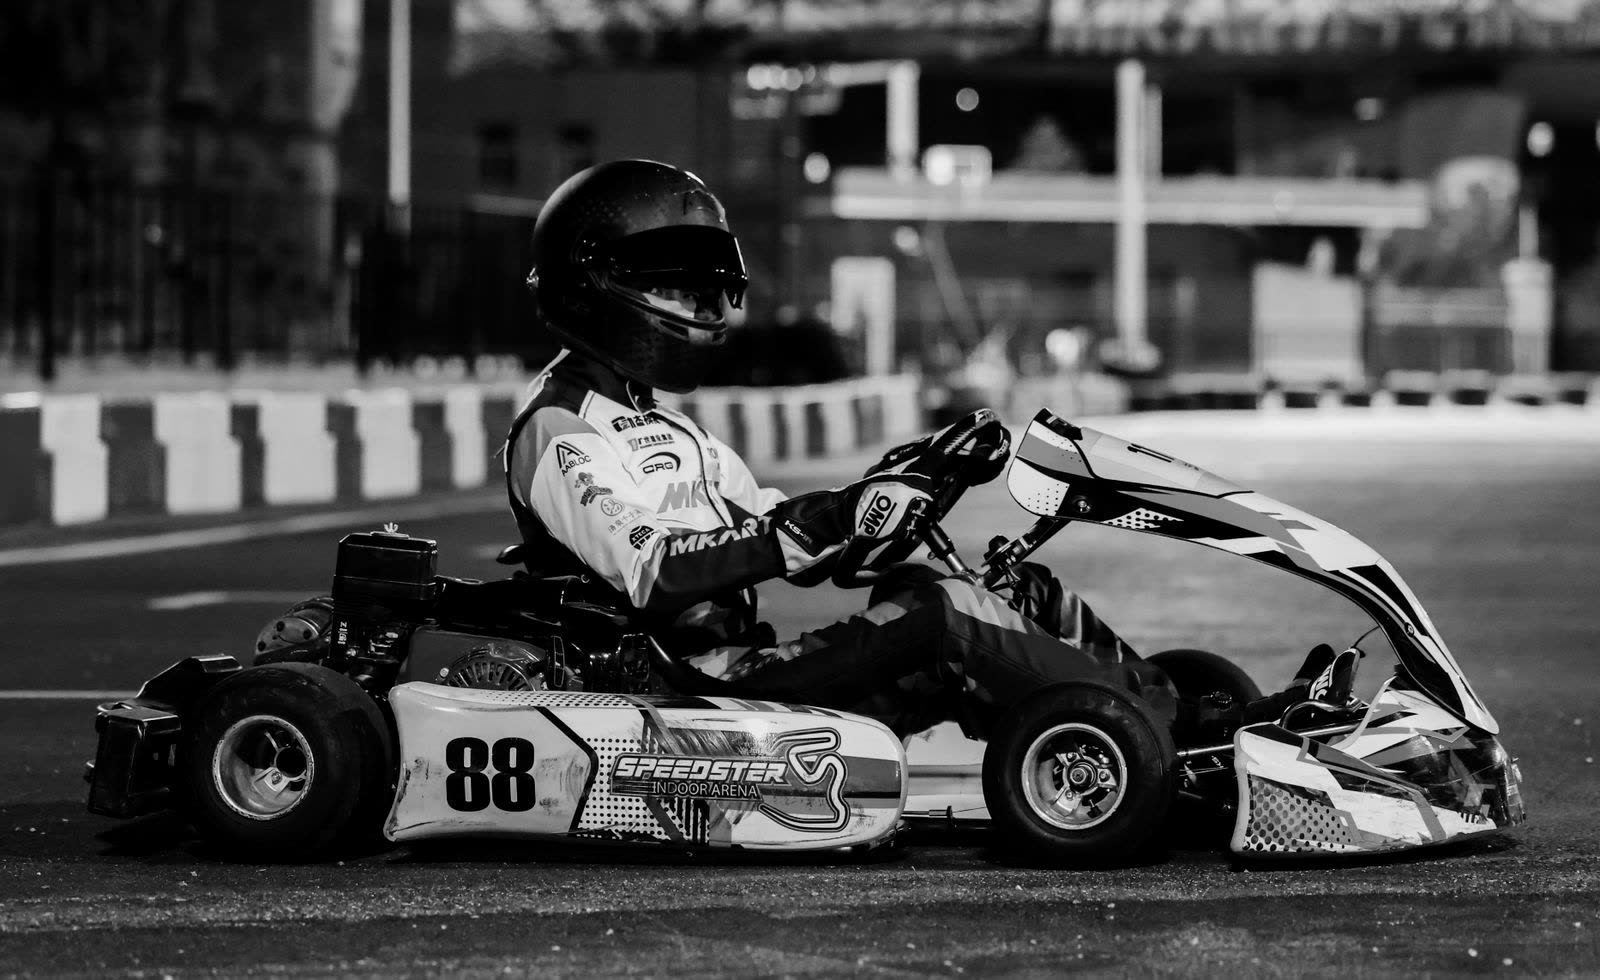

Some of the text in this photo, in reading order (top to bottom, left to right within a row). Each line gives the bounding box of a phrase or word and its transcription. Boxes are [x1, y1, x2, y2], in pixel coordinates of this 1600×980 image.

[561, 455, 592, 477] AABLOC
[642, 461, 674, 474] CRG
[864, 495, 892, 536] OMP
[669, 516, 773, 557] MKART
[445, 737, 536, 812] 88
[614, 757, 788, 783] SPEEDSTER
[653, 781, 758, 798] INDOOR ARENA
